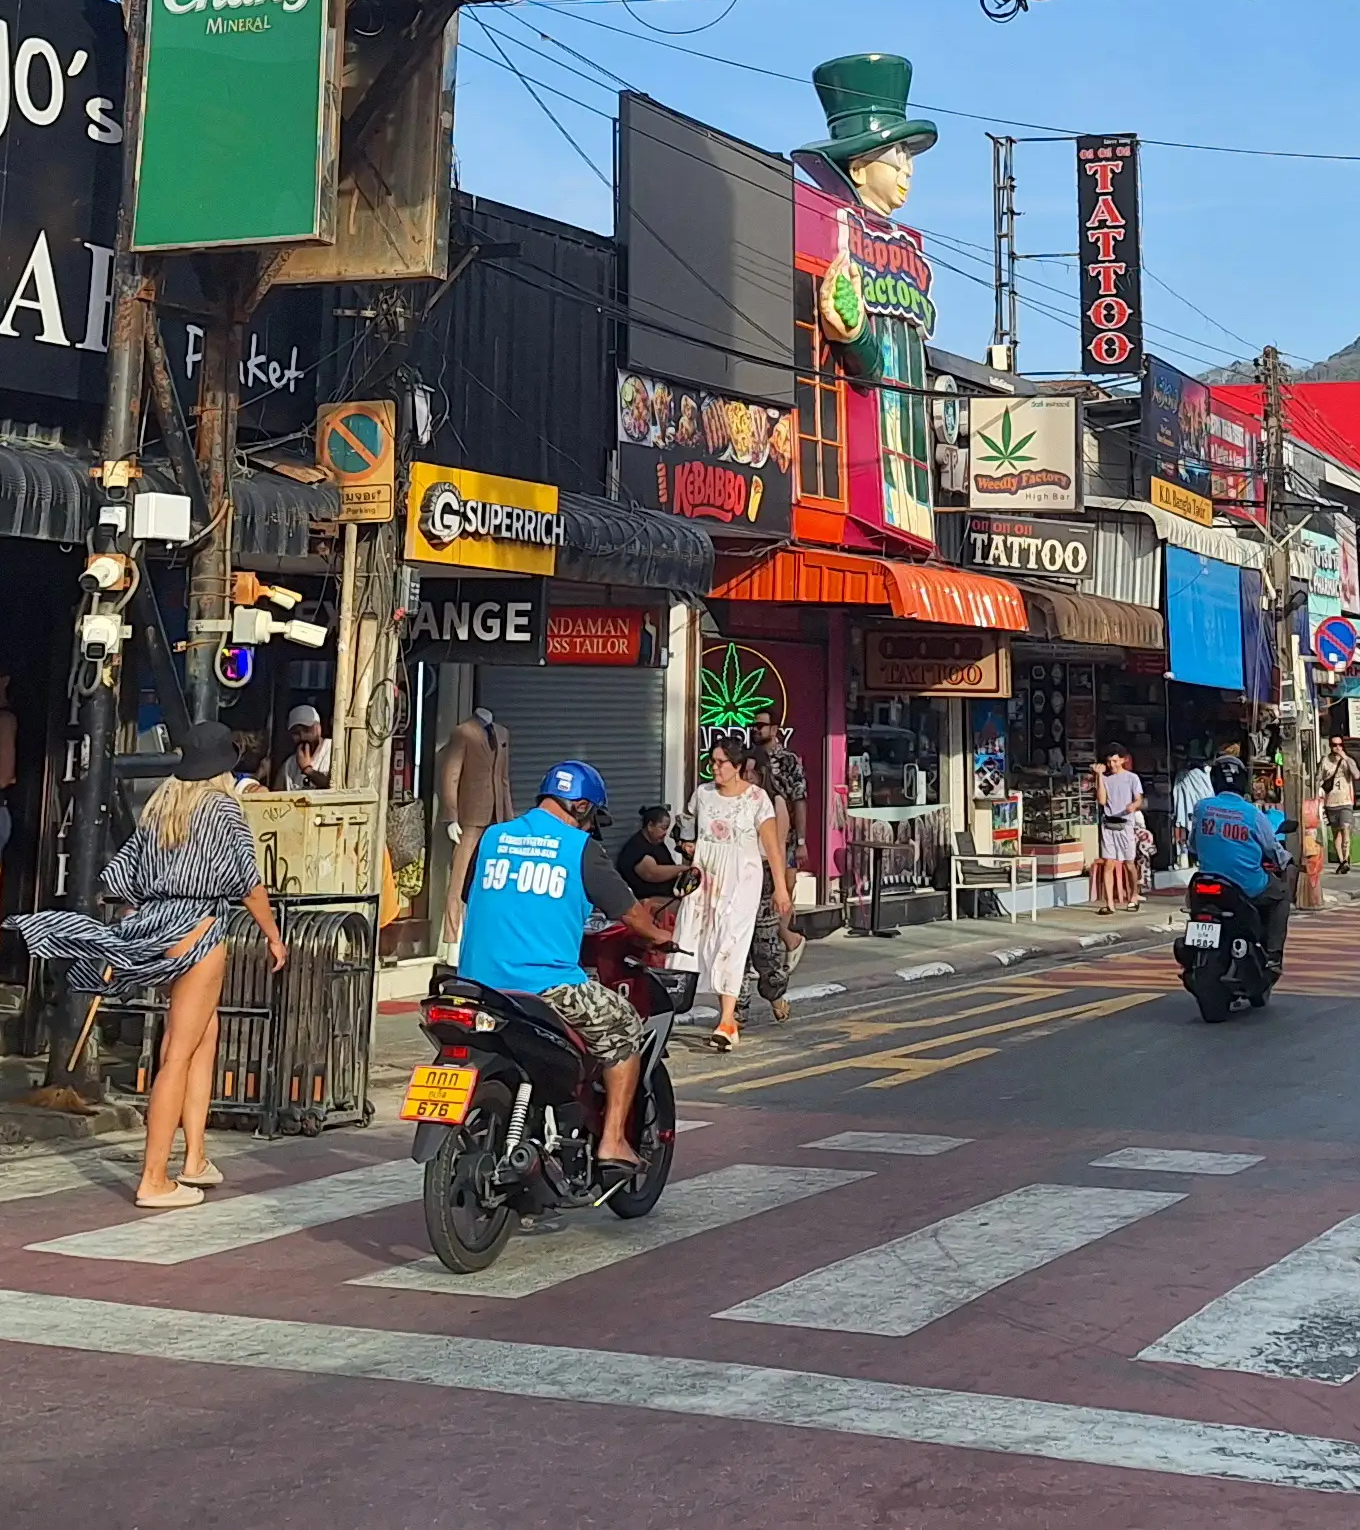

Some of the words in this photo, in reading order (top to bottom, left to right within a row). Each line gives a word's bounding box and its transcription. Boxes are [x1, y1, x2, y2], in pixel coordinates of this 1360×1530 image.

[205, 15, 272, 36] MINERAL
[1085, 160, 1135, 365] TATTOO
[976, 476, 1018, 492] Weedly
[1020, 470, 1068, 487] Factory
[1025, 493, 1049, 503] High
[1052, 493, 1070, 501] Bar
[465, 499, 566, 547] SUPERRICH
[970, 532, 1088, 574] TATTOO
[547, 617, 630, 638] NDAMAN
[573, 638, 630, 655] TAILOR
[882, 663, 984, 686] TATTOO
[482, 858, 567, 899] 59-006
[426, 1072, 459, 1086] กกก
[417, 1102, 449, 1117] 676
